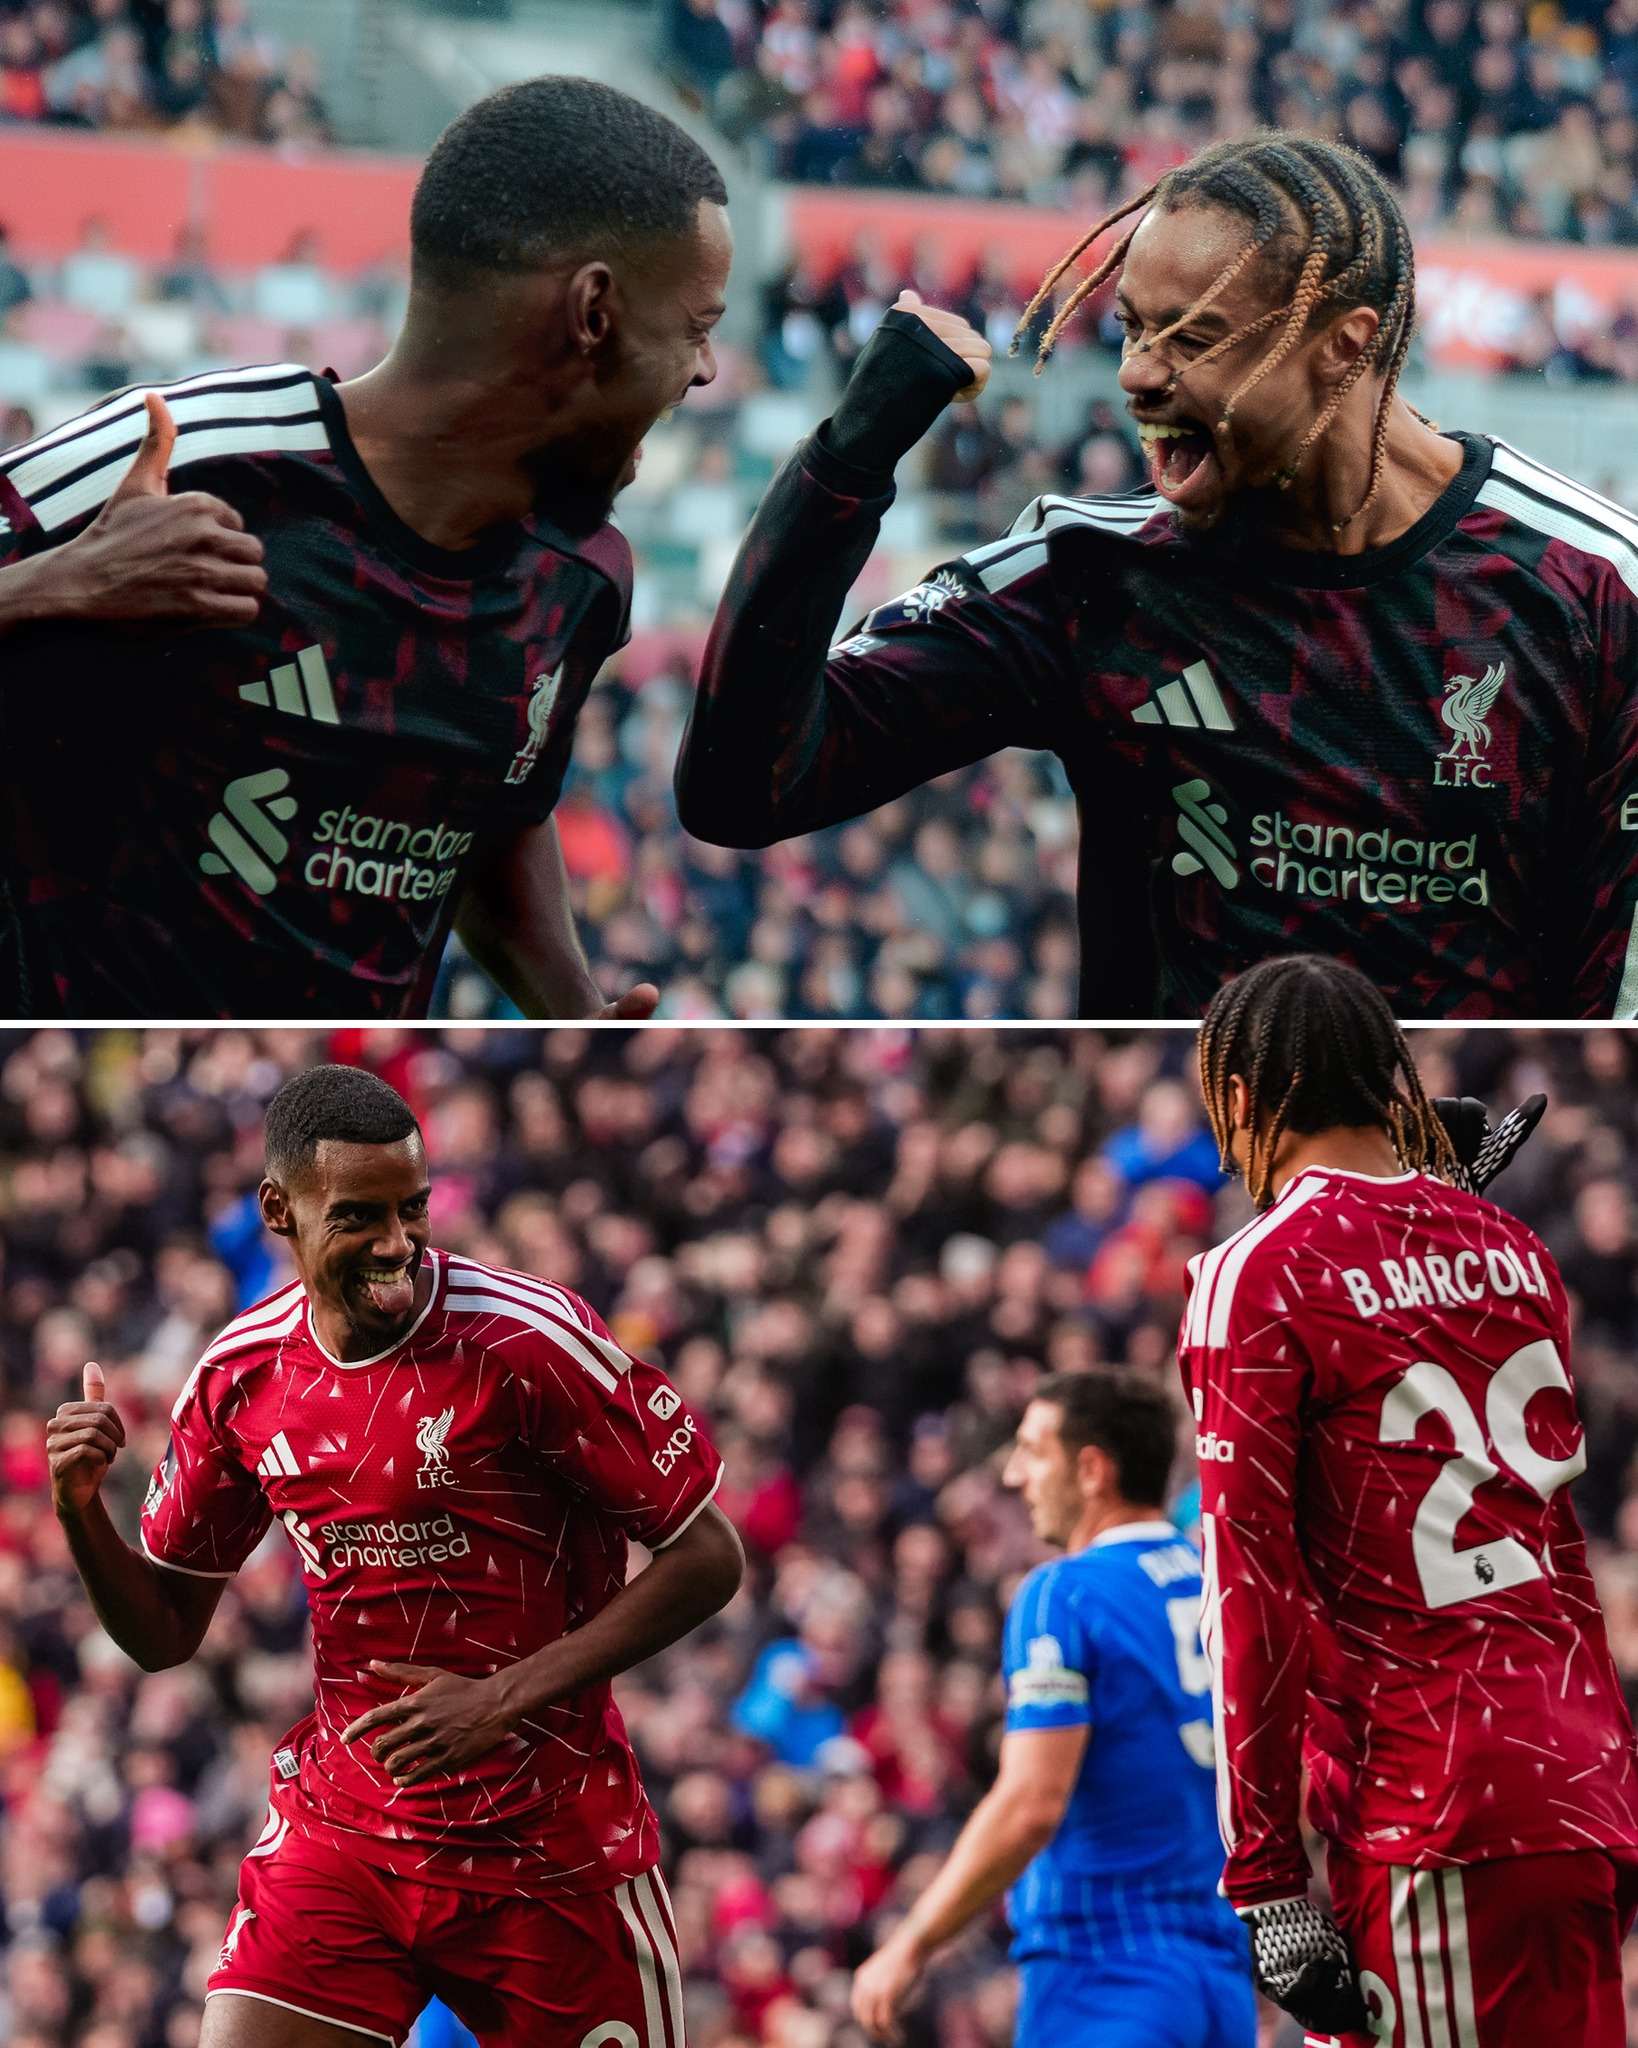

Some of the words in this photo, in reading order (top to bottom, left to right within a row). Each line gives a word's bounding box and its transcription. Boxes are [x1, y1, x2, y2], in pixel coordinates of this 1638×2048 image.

[1433, 761, 1496, 788] L.F.C.
[1250, 811, 1477, 870] standard
[1250, 851, 1488, 906] chartered
[416, 1470, 460, 1489] L.F.C.
[321, 1513, 455, 1544] standard
[331, 1531, 471, 1568] chartered
